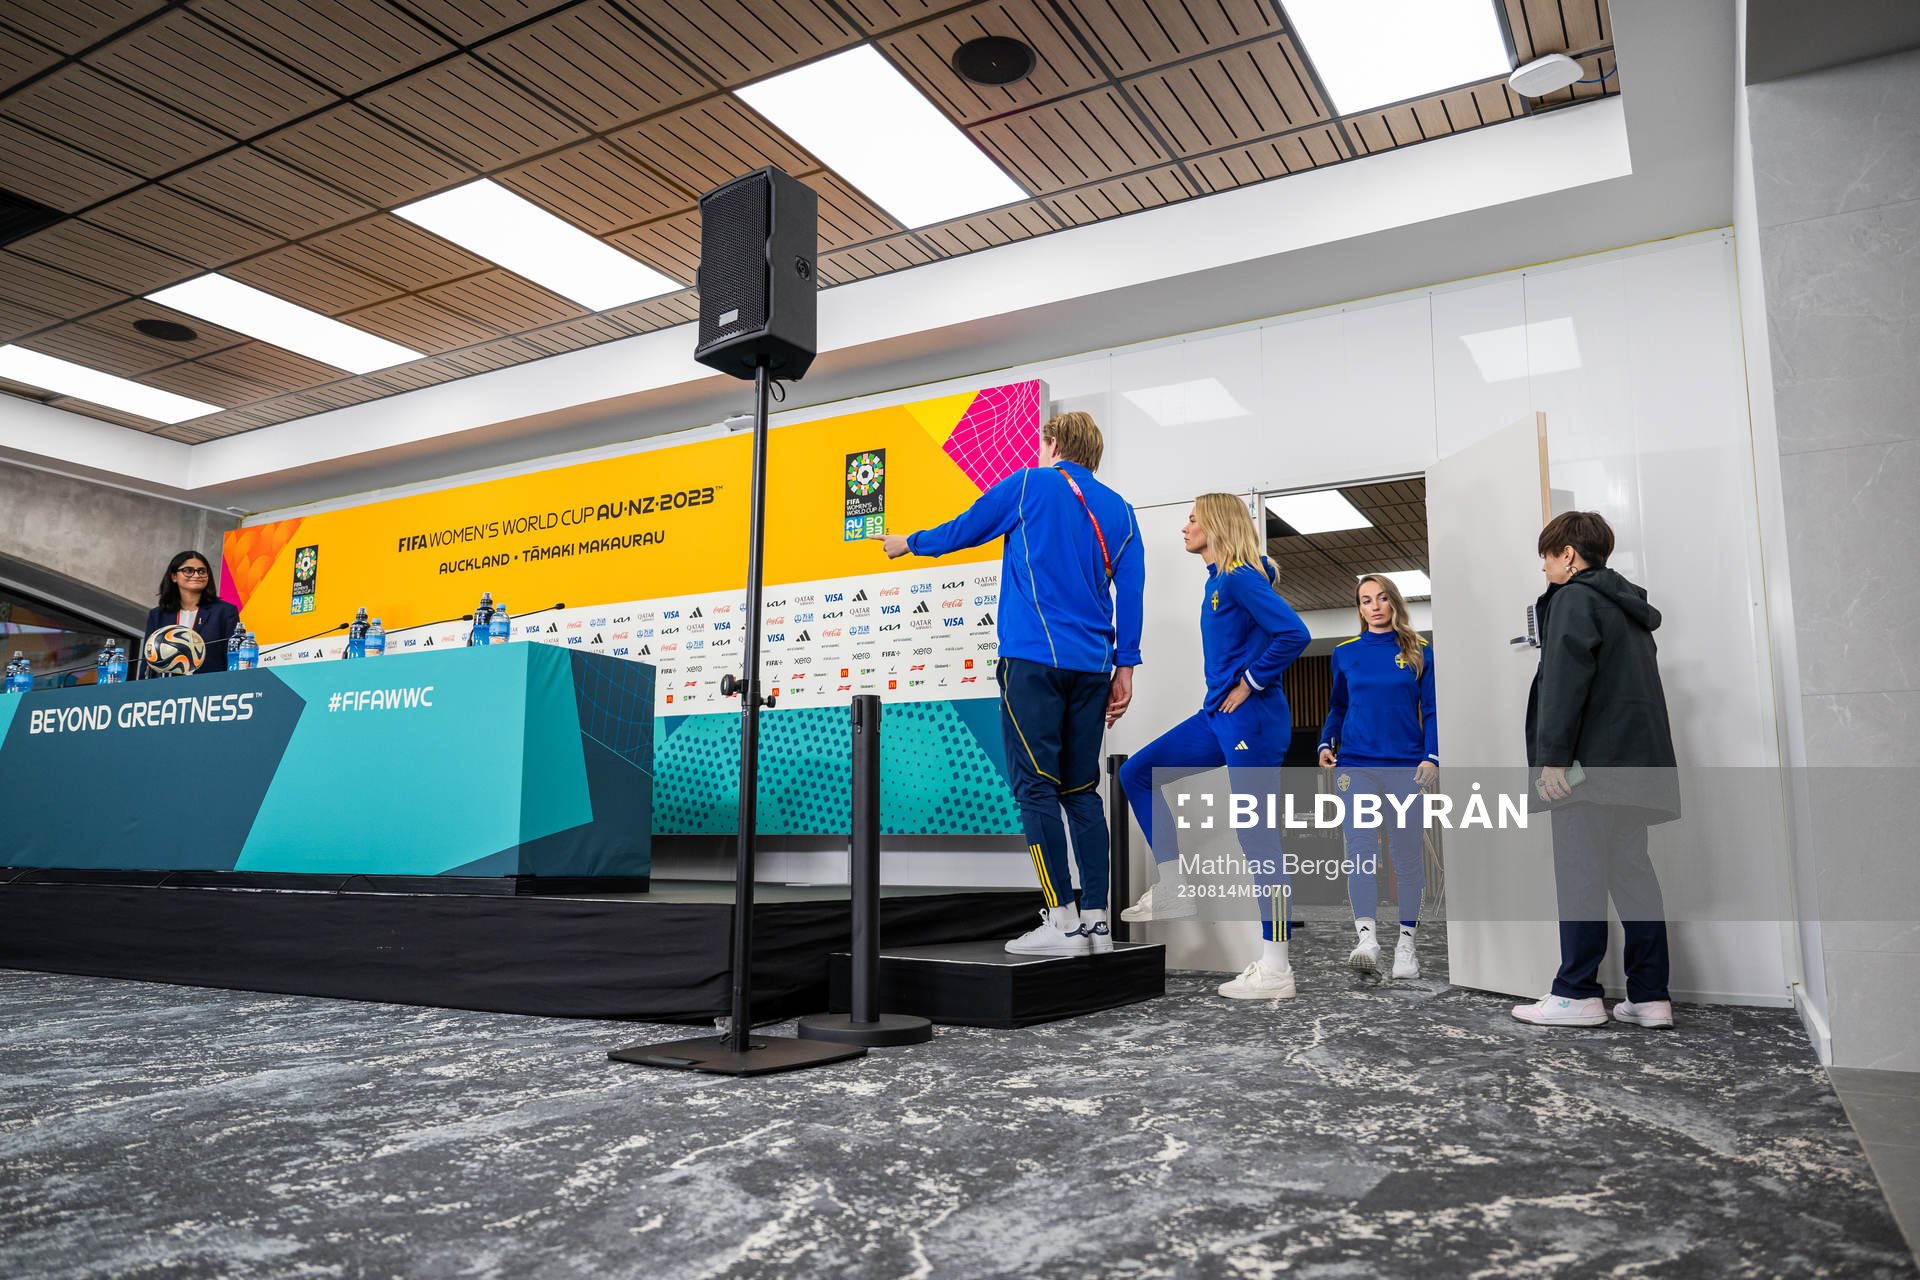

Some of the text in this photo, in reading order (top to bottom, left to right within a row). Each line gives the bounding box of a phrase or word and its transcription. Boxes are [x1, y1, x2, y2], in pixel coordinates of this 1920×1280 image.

[846, 518, 863, 530] AU
[866, 516, 883, 527] 20
[398, 534, 427, 552] FIFA
[429, 521, 499, 548] WOMEN'S
[502, 512, 558, 536] WORLD
[560, 506, 595, 526] CUP
[845, 528, 862, 540] NZ
[439, 529, 666, 575] AUCKLAND TĀMAKI MAKAURAU
[974, 575, 997, 585] QATAR
[794, 595, 814, 604] QATAR
[824, 593, 844, 603] VISA
[849, 607, 870, 615] QATAR
[881, 605, 901, 614] VISA
[663, 610, 680, 619] VISA
[713, 621, 731, 631] VISA
[910, 619, 932, 628] QATAR
[943, 617, 964, 627] VISA
[525, 625, 540, 634] VISA
[567, 636, 582, 645] VISA
[767, 633, 785, 643] VISA
[404, 639, 417, 647] VISA
[977, 642, 998, 651] xero
[613, 647, 629, 656] VISA
[852, 652, 871, 660] xero
[912, 647, 933, 656] xero
[794, 657, 812, 665] xero
[686, 665, 703, 673] xero
[328, 685, 434, 713] #FIFAWWC
[29, 704, 112, 735] BEYOND
